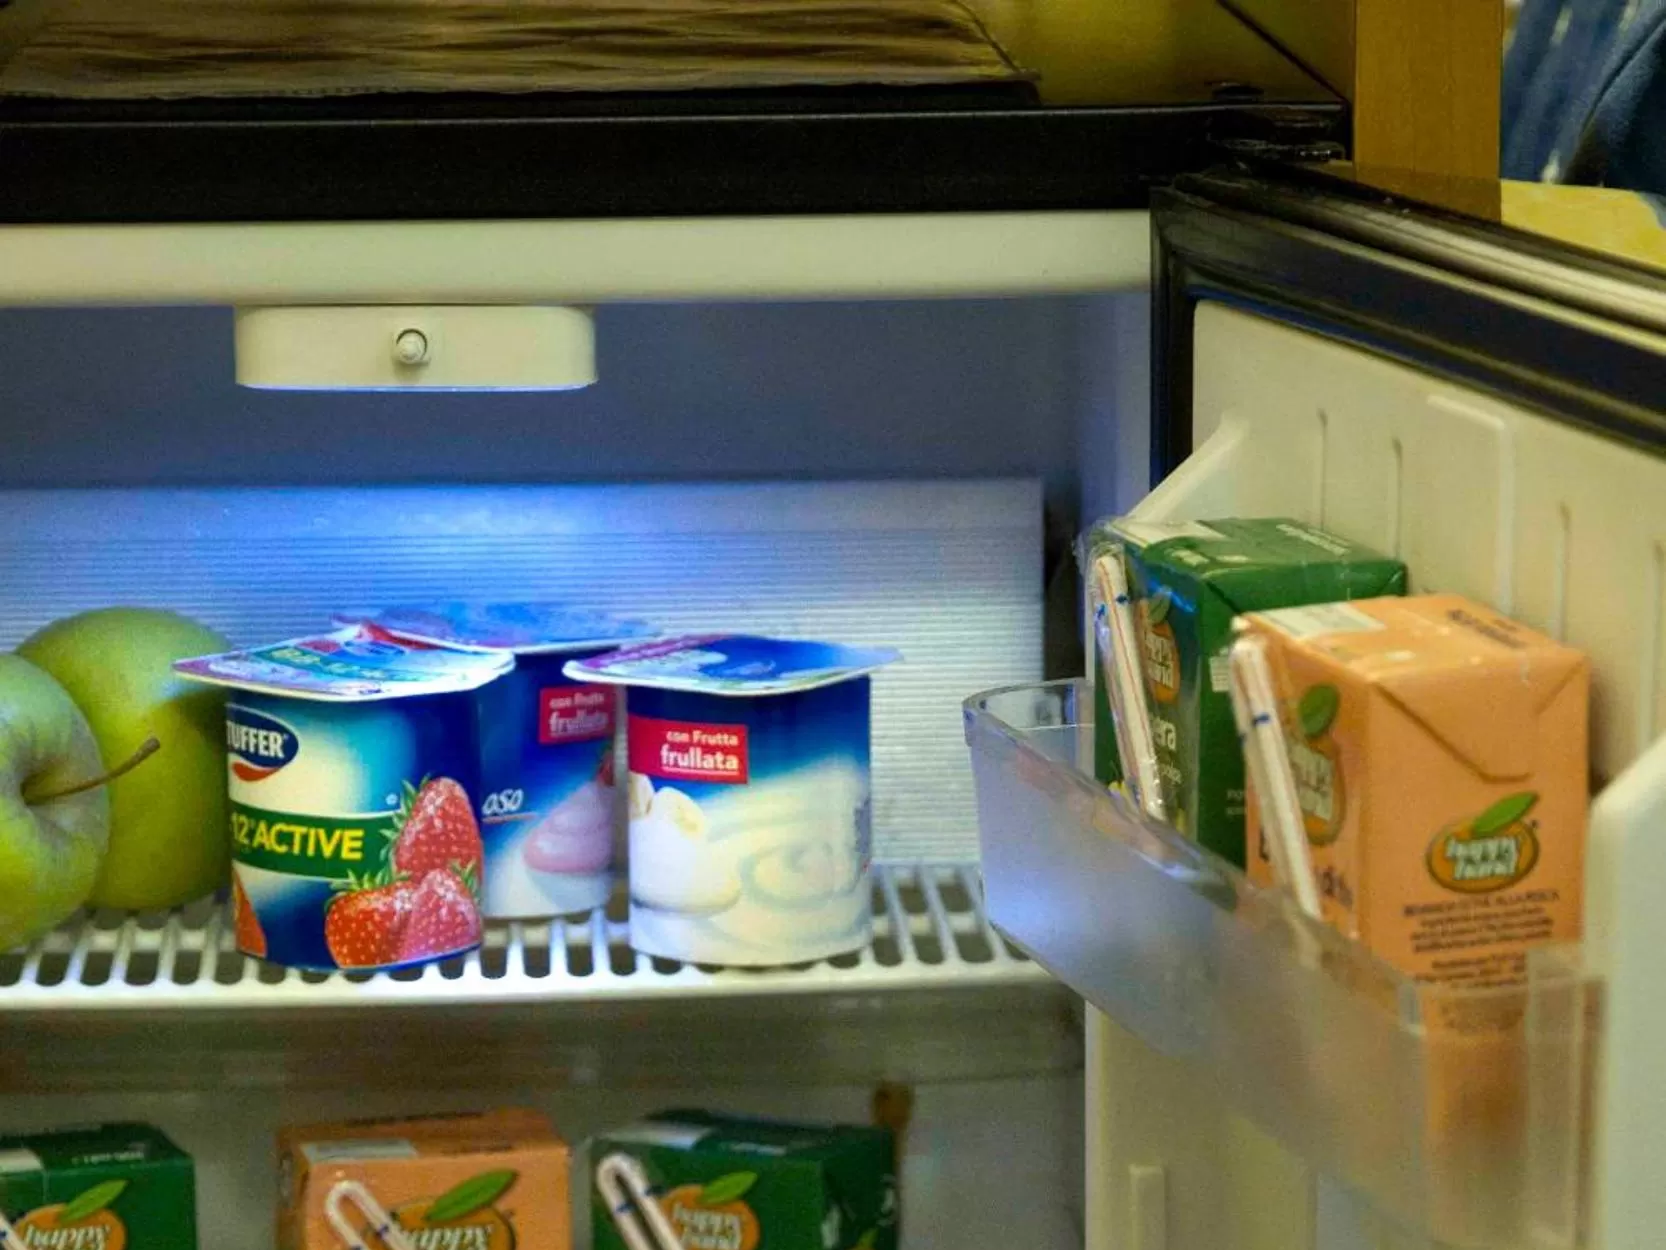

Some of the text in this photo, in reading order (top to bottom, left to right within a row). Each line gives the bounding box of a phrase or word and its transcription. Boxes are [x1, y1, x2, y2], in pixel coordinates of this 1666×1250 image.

[665, 730, 739, 746] con Frutta
[661, 743, 740, 770] frullata
[252, 821, 364, 860] ACTIVE
